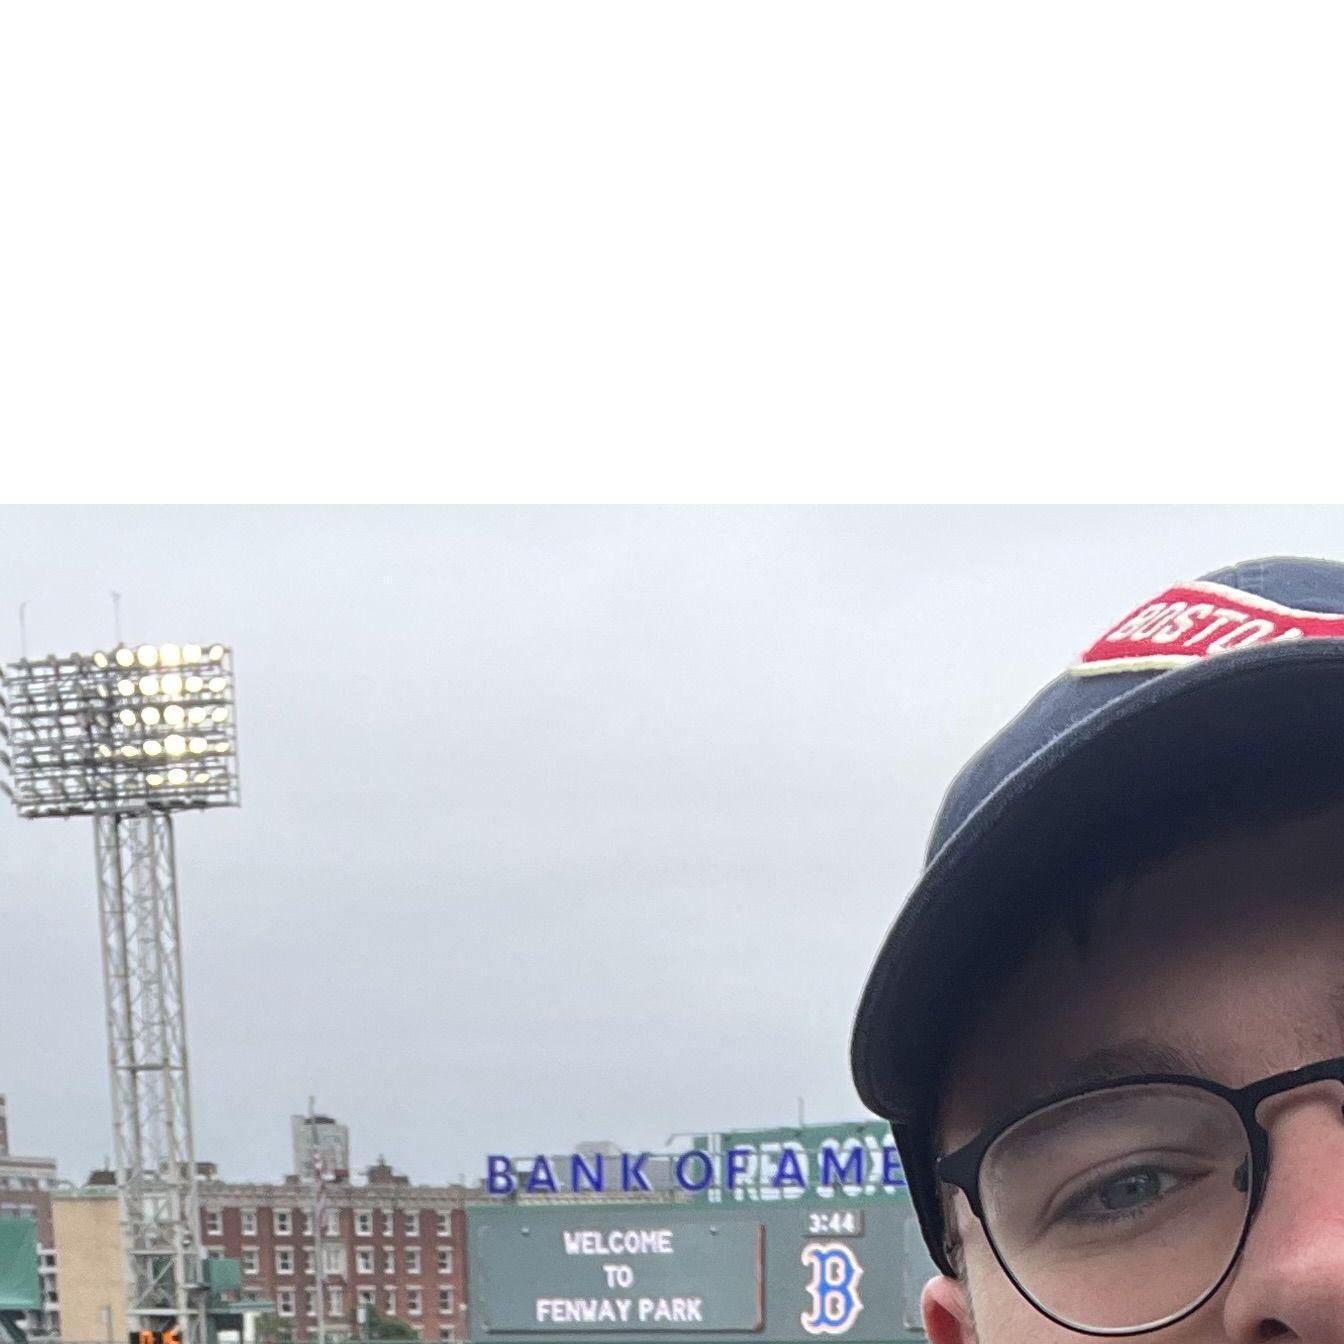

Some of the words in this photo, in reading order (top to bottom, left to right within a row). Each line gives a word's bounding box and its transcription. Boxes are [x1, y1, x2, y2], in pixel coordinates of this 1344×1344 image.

[1106, 600, 1304, 655] BOSTO
[487, 1152, 652, 1196] BANK
[676, 1148, 752, 1191] OF
[772, 1144, 907, 1189] AME
[808, 1213, 855, 1234] 3:44
[563, 1230, 674, 1255] WELCOME
[603, 1265, 634, 1290] TO
[536, 1300, 632, 1324] FENWAY
[639, 1300, 703, 1324] PARK
